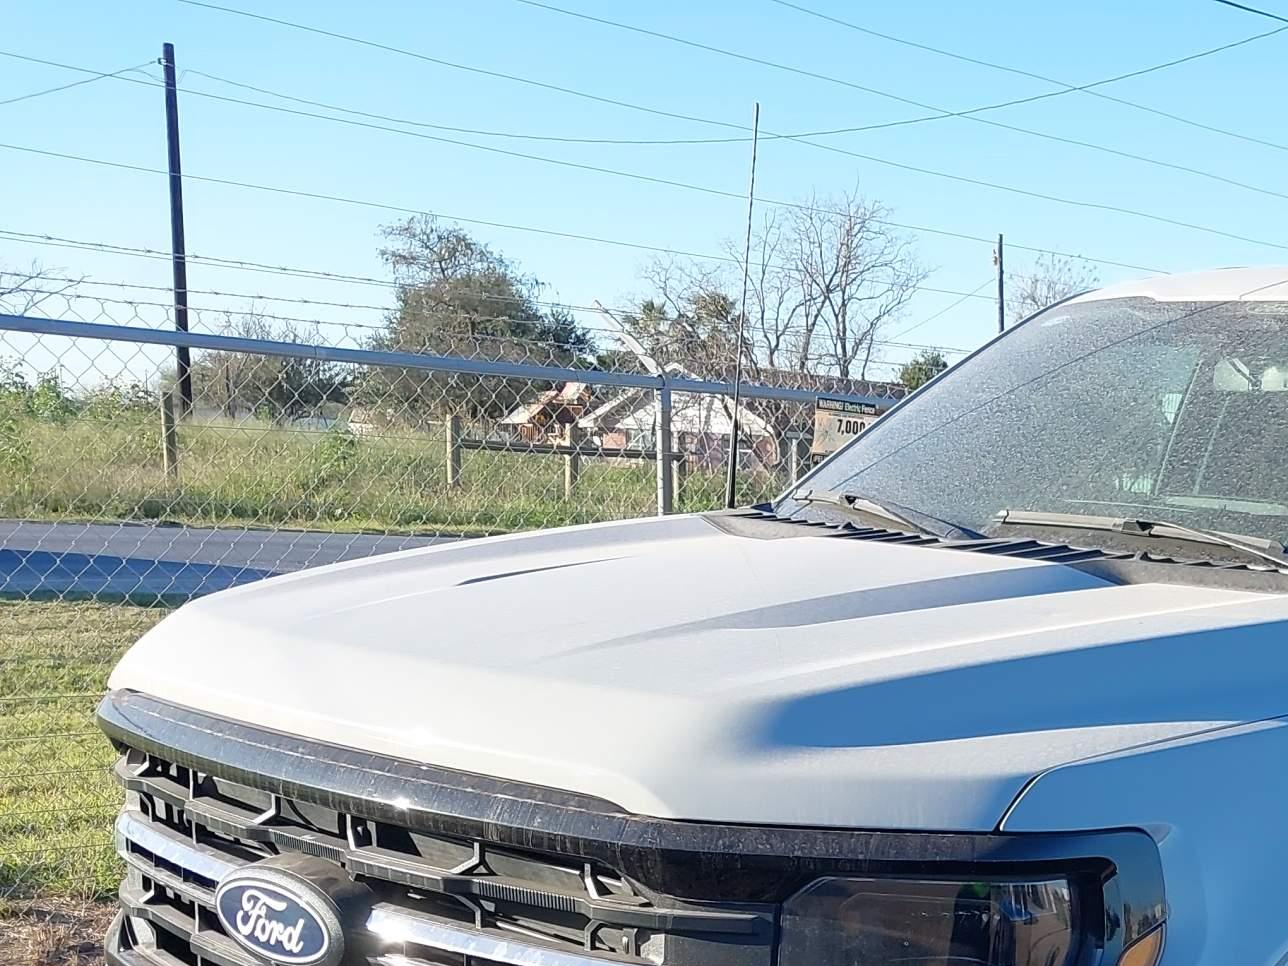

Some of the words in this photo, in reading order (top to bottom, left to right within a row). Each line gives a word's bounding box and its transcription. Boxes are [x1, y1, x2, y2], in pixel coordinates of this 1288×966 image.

[818, 399, 844, 410] WARNING!
[844, 403, 861, 414] Electric
[861, 405, 876, 414] Fence
[837, 419, 866, 435] 7,000
[236, 889, 305, 953] Ford
